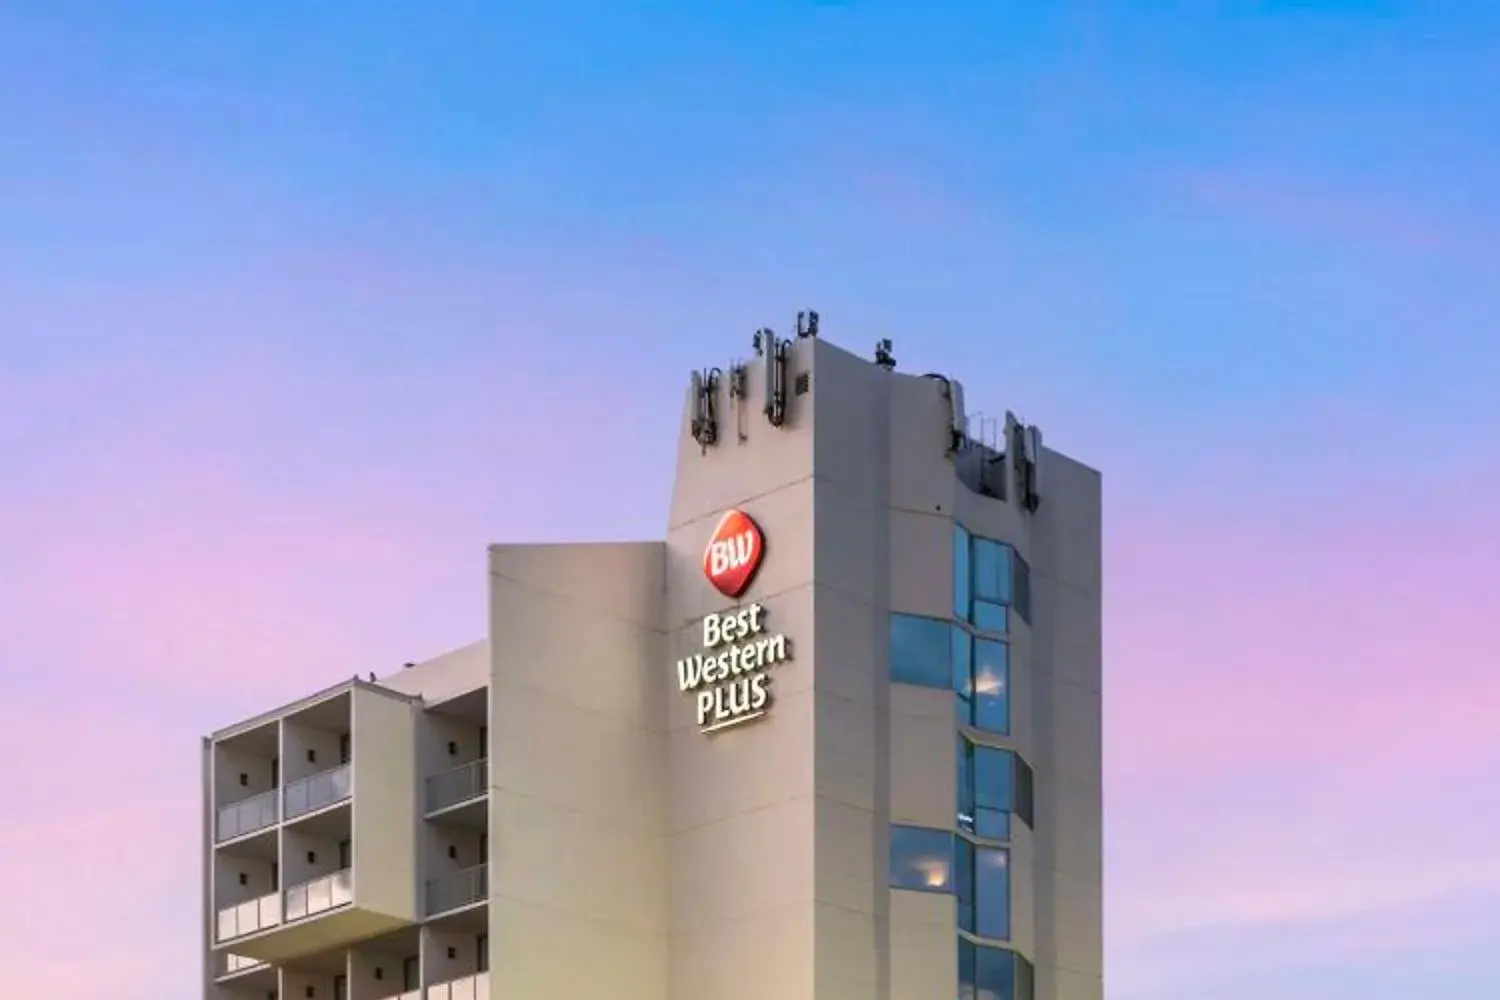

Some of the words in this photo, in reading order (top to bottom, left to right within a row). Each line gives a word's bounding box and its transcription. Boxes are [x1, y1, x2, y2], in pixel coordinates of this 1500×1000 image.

[710, 530, 754, 577] BW
[703, 602, 763, 648] Best
[676, 632, 786, 692] Western
[696, 672, 768, 725] PLUS
